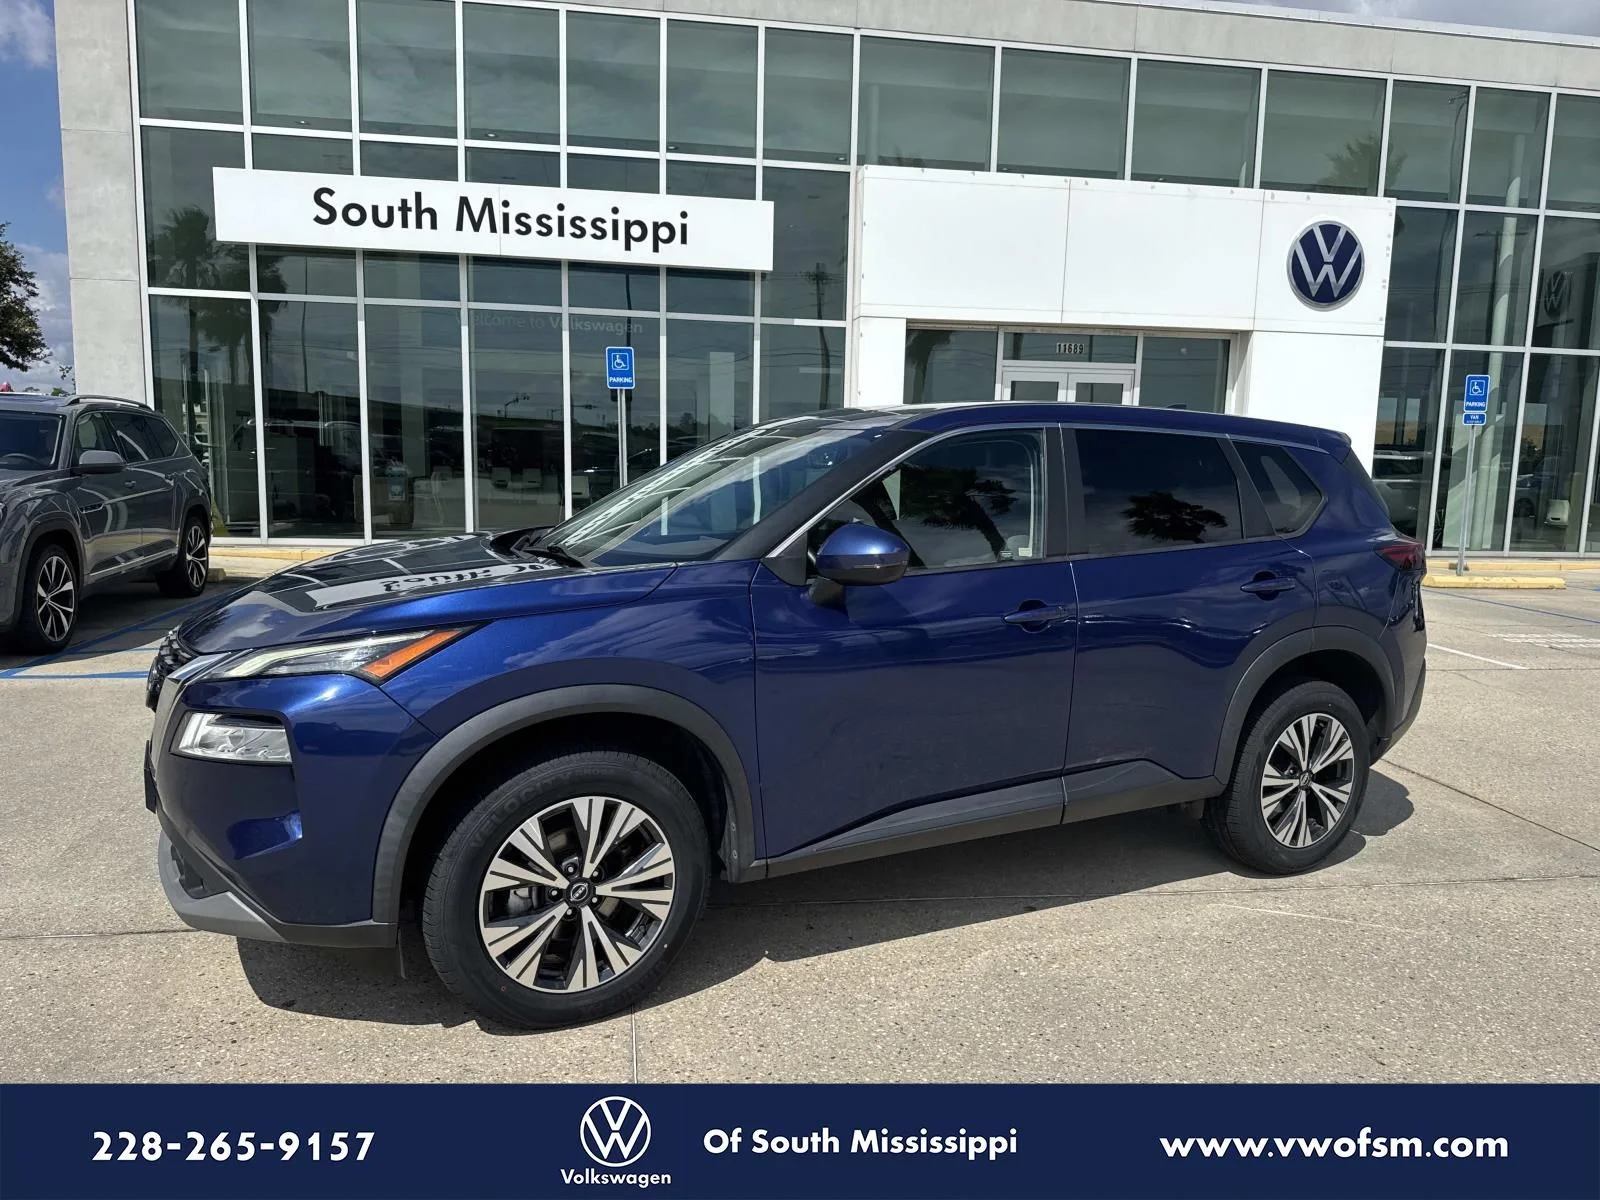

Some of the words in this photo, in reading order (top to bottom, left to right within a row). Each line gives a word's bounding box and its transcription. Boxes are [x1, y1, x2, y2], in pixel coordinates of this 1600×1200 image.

[313, 187, 438, 231] South
[456, 195, 688, 254] Mississippi
[609, 376, 633, 384] PARKING
